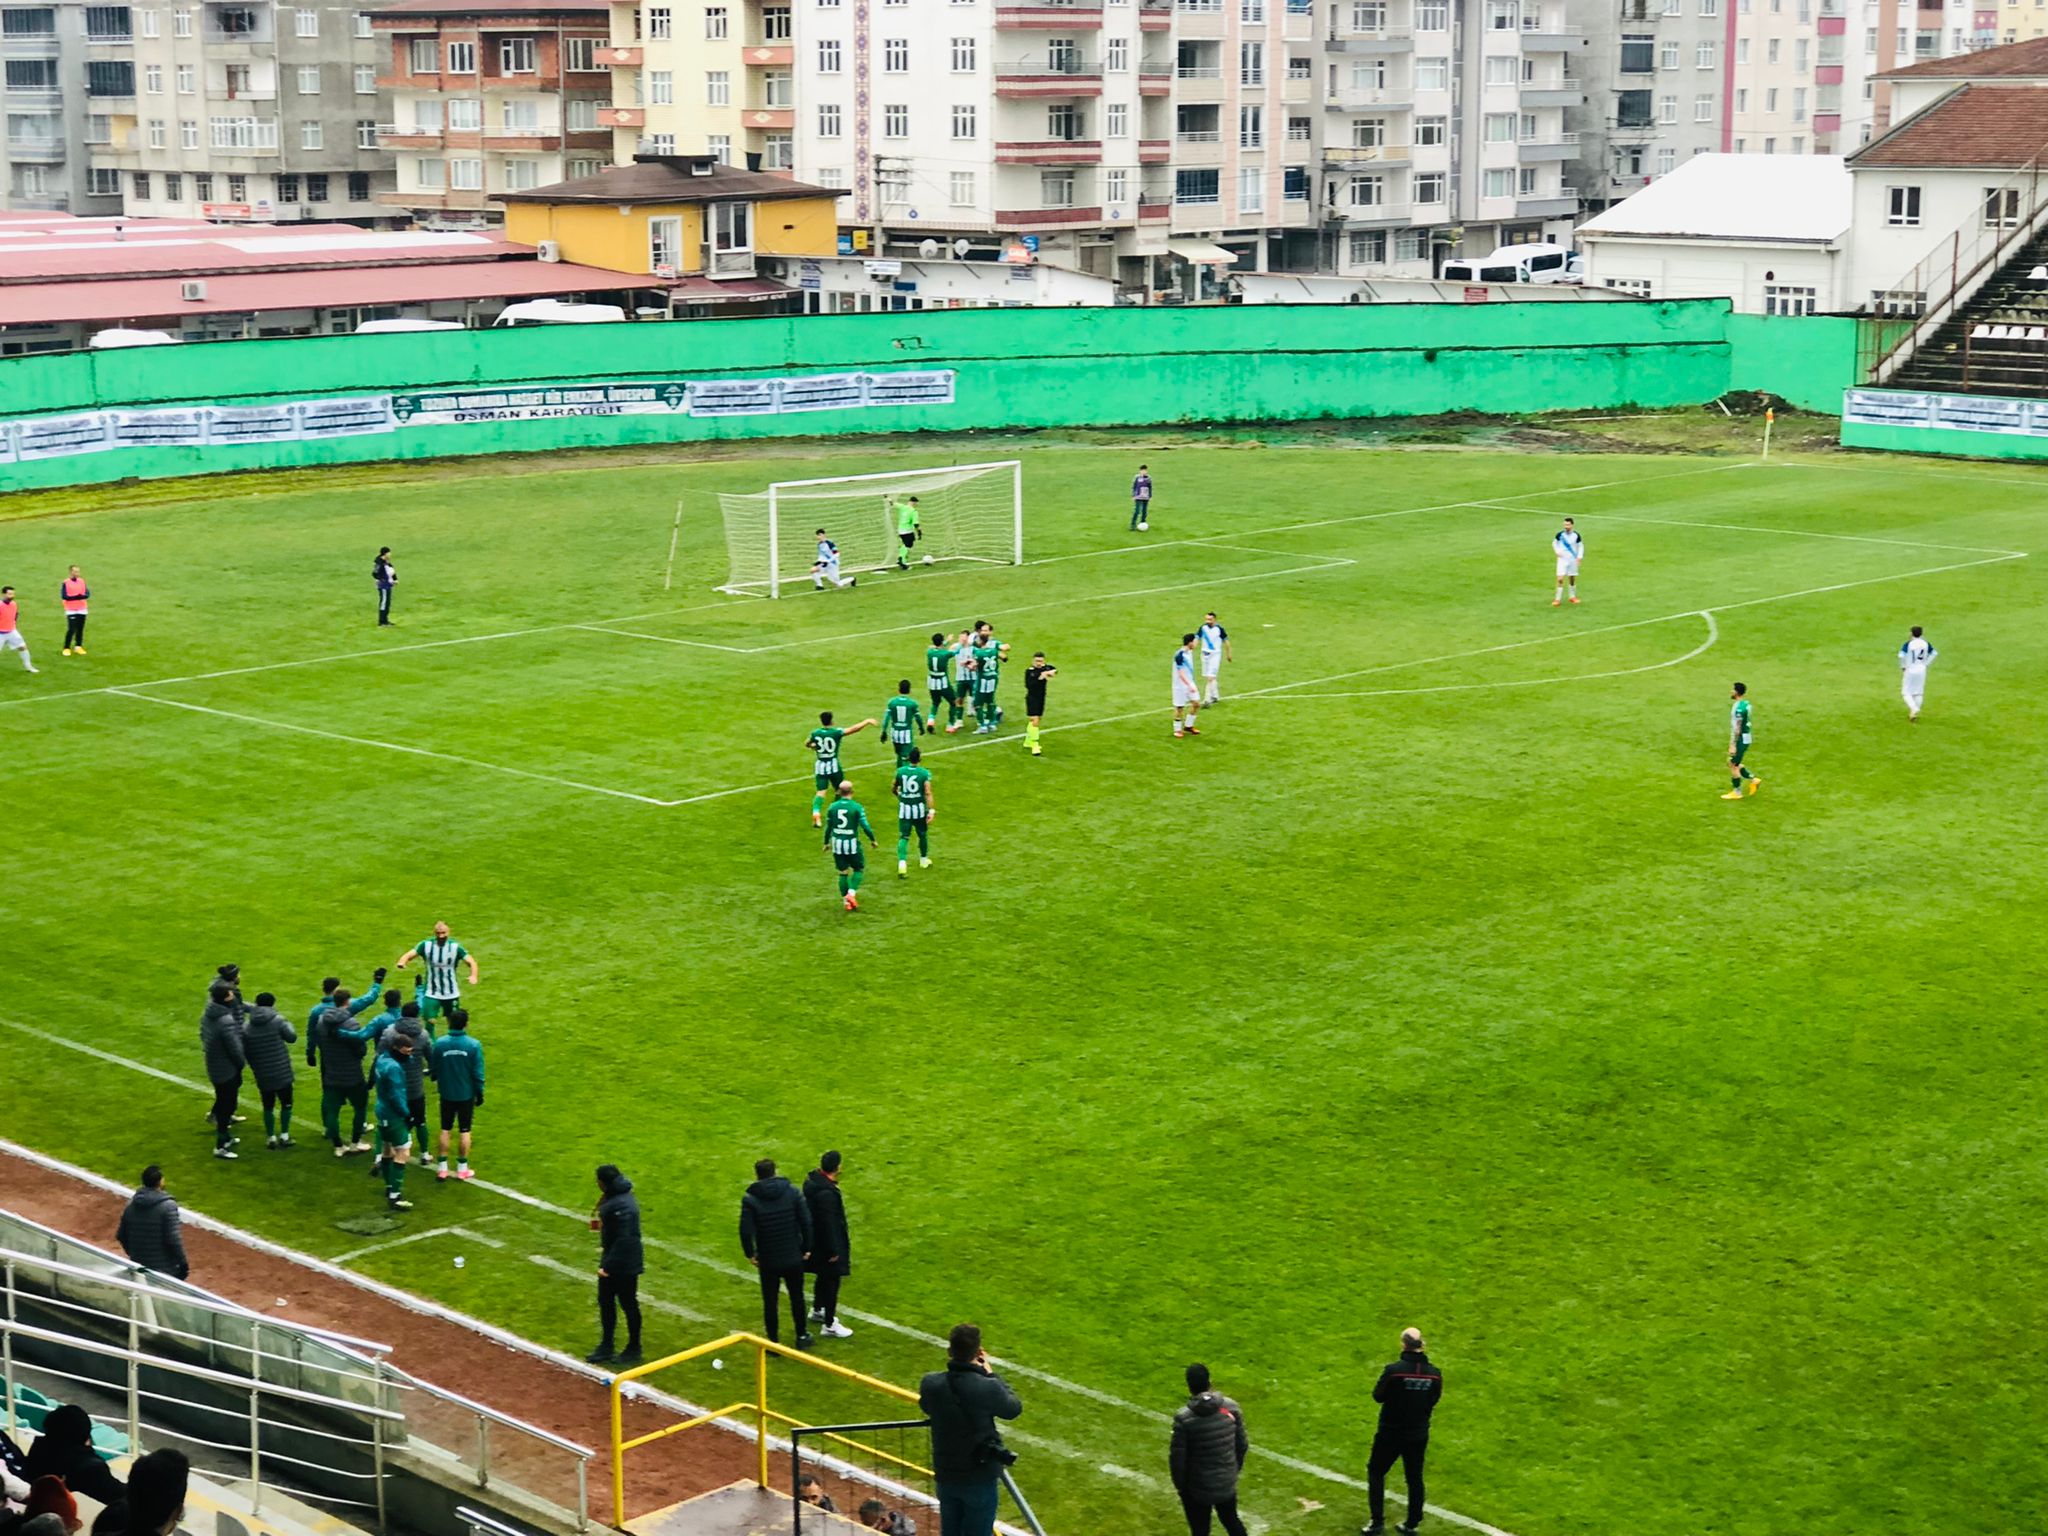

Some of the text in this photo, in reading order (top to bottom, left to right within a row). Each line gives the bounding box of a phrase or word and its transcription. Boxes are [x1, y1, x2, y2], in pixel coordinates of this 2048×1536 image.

[454, 410, 521, 422] OSMAN
[814, 736, 837, 754] 30
[901, 774, 920, 793] 16
[836, 808, 849, 829] 5
